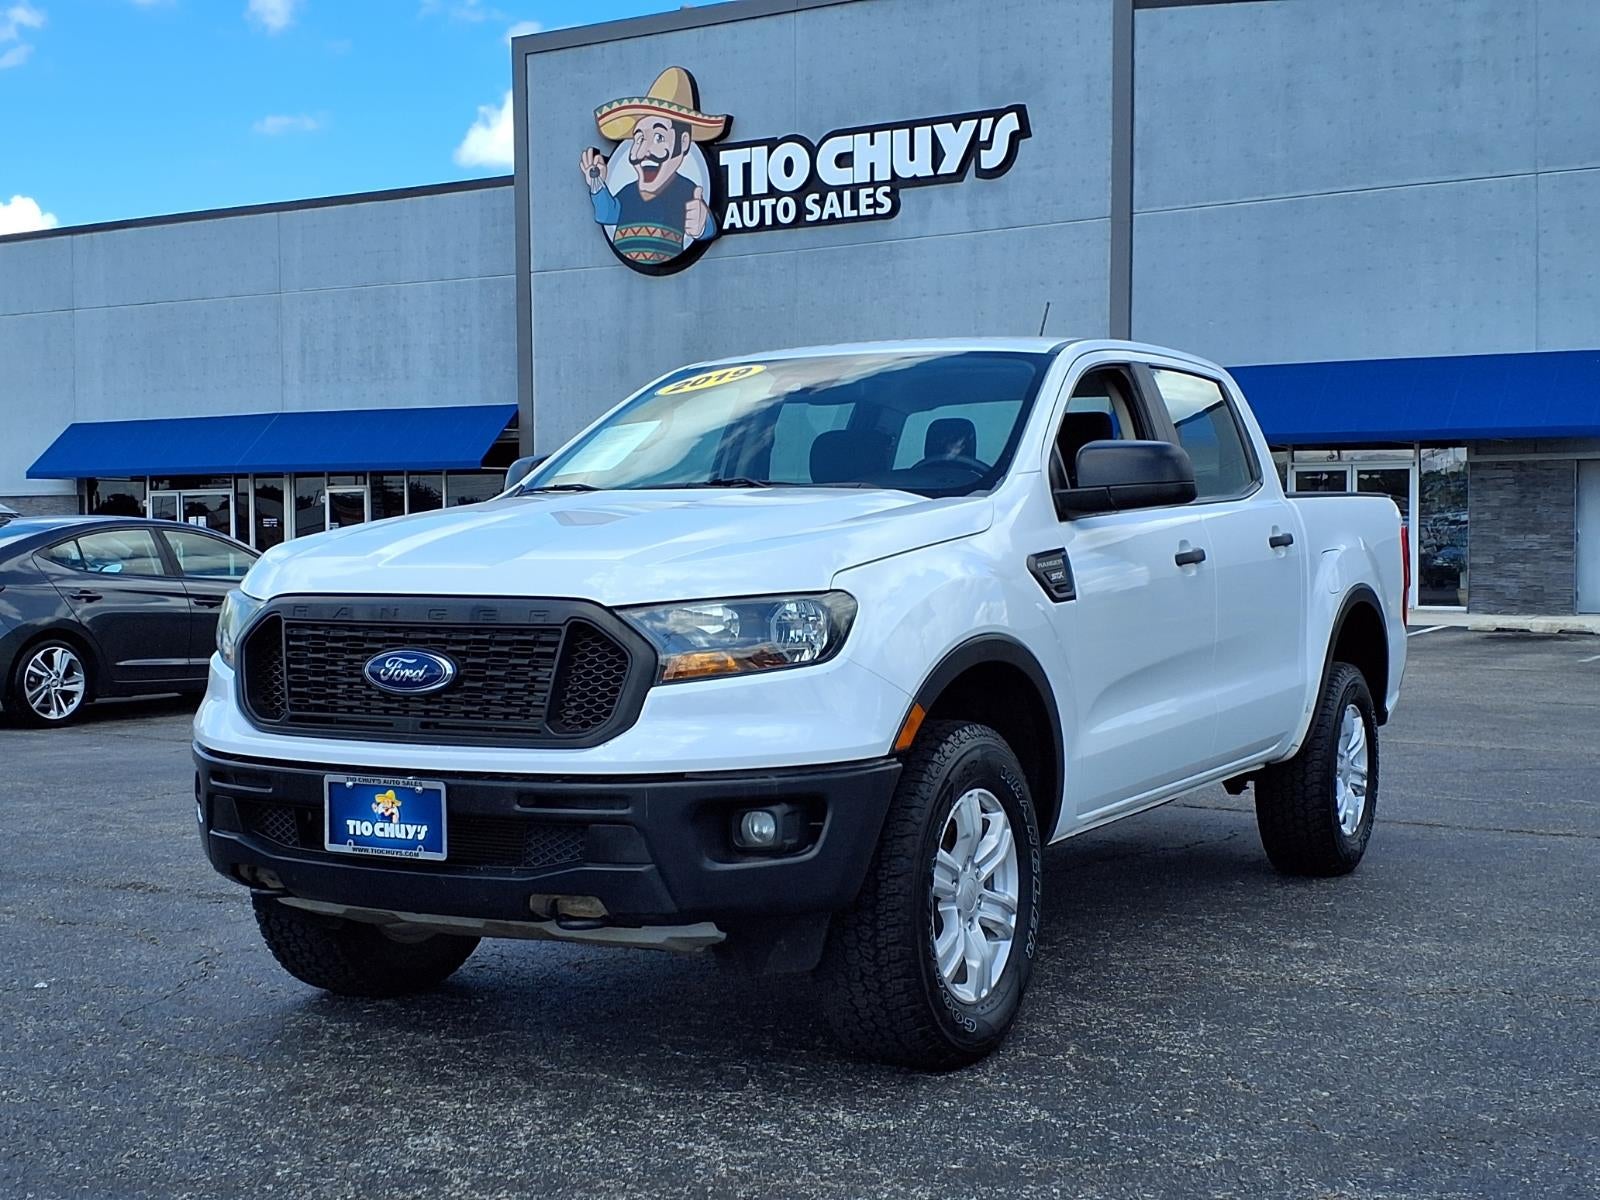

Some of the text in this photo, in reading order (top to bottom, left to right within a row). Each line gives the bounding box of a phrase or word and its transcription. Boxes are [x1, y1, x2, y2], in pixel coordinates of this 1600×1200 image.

[719, 111, 1020, 198] TIO CHUY'S
[722, 185, 892, 230] AUTO SALES
[665, 367, 754, 394] 2019
[292, 605, 550, 624] RANGER
[379, 657, 428, 683] Ford
[402, 780, 423, 788] SALES
[346, 819, 428, 840] TIO CHUY'S
[352, 846, 420, 858] WWW.TIOCHUYS.COM
